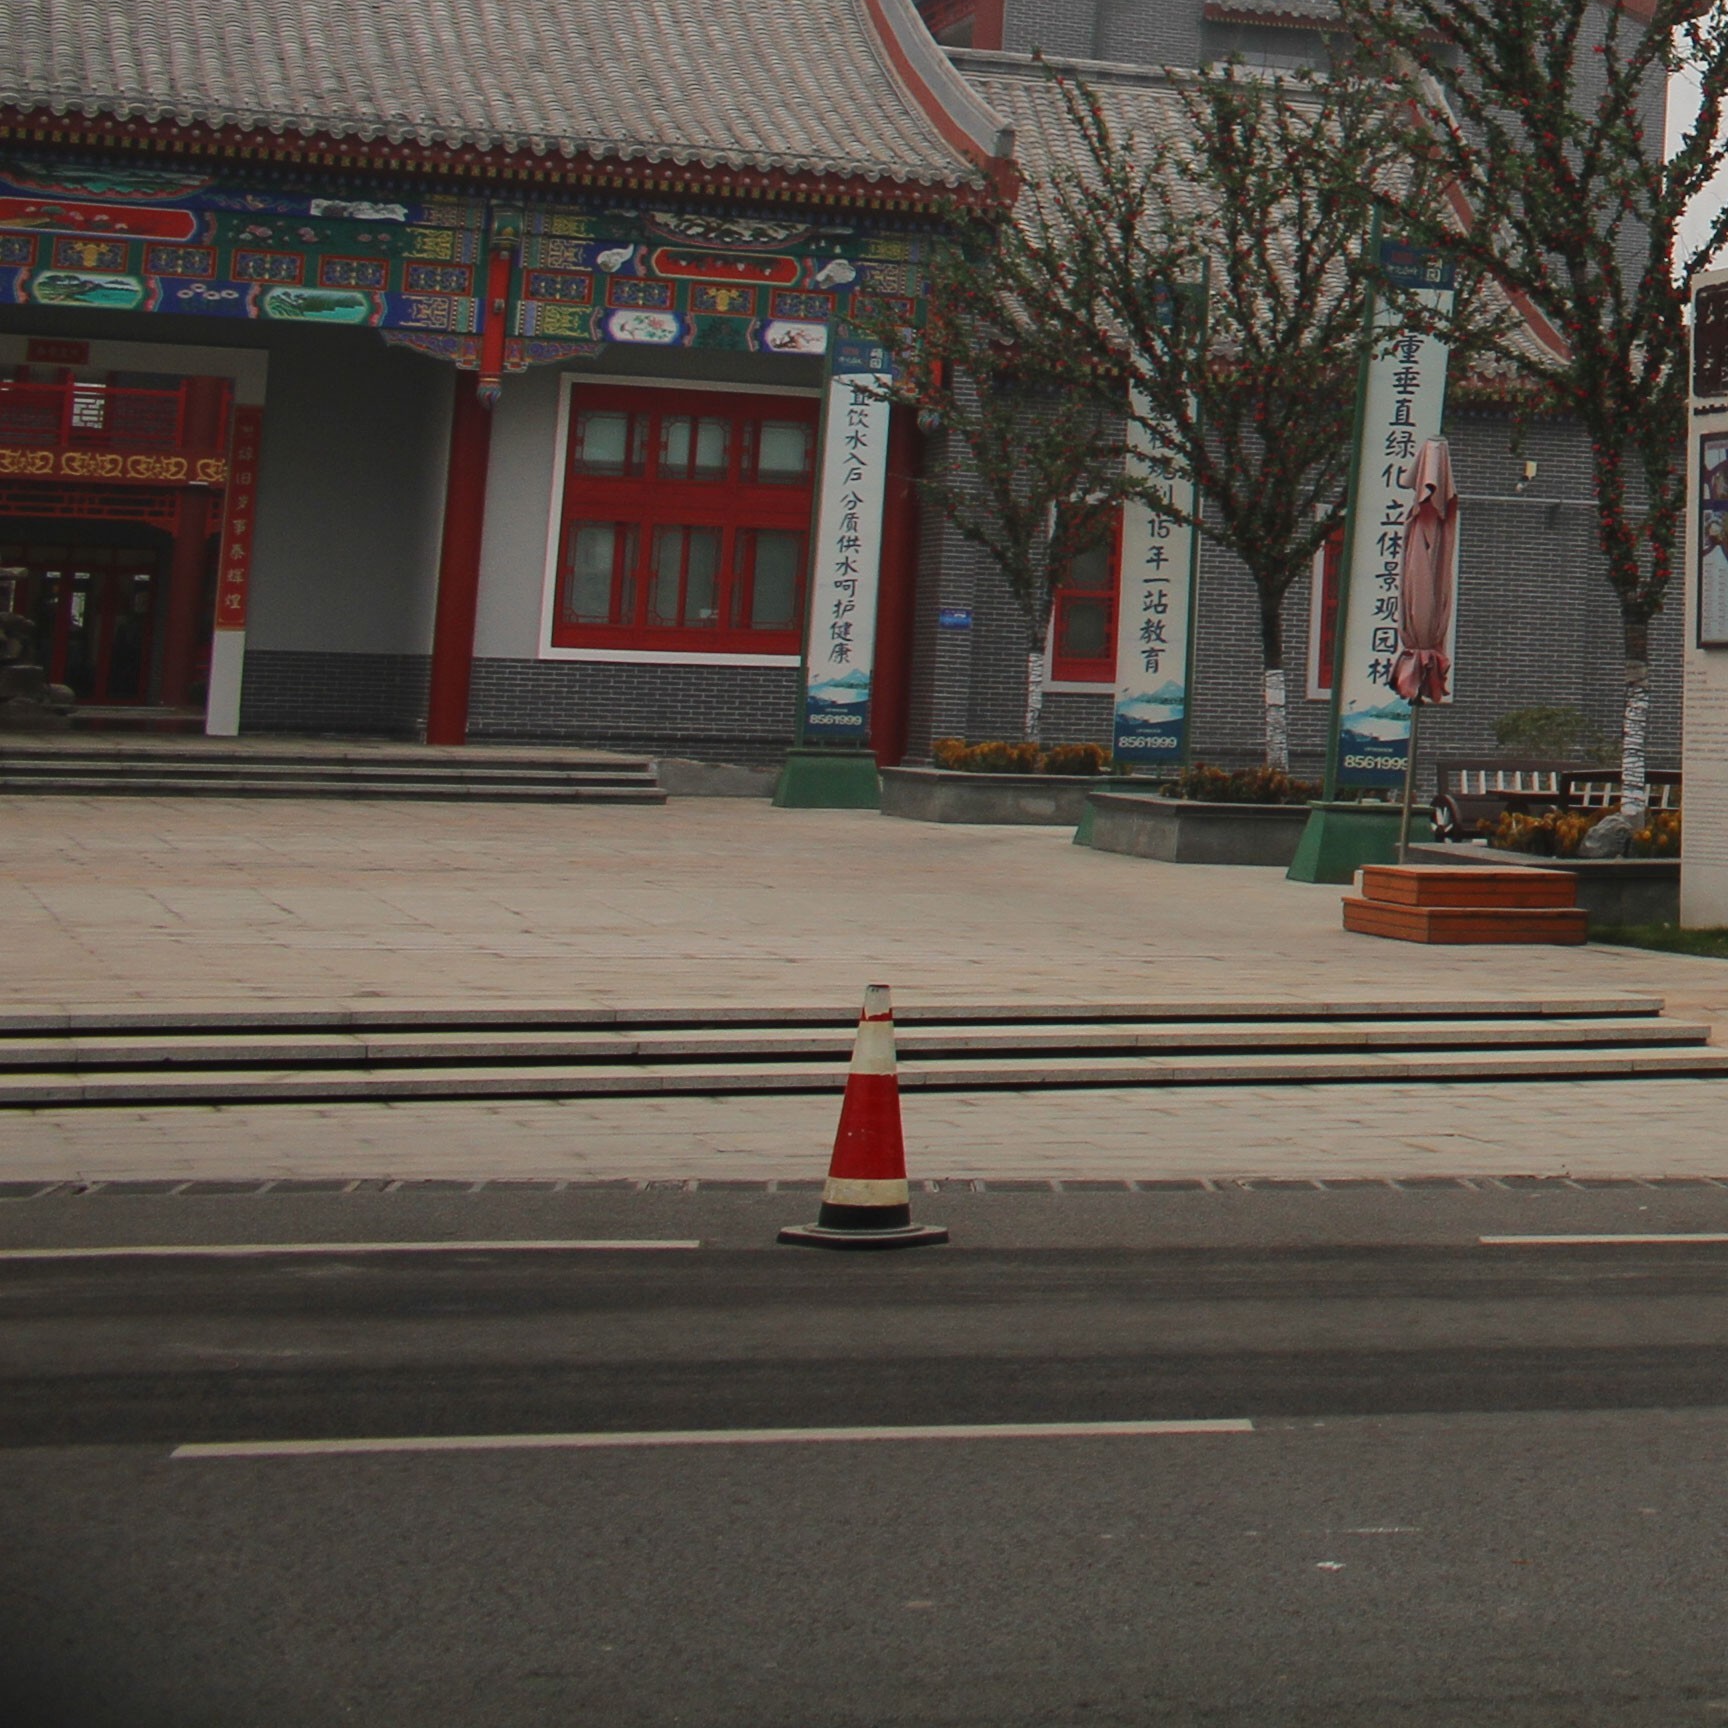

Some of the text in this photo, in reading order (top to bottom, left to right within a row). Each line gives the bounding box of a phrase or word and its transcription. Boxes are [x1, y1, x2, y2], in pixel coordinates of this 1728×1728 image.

[1367, 302, 1424, 685] 重垂直绿化立体景观园林
[809, 714, 863, 726] 8561999
[1118, 736, 1177, 748] 8561999
